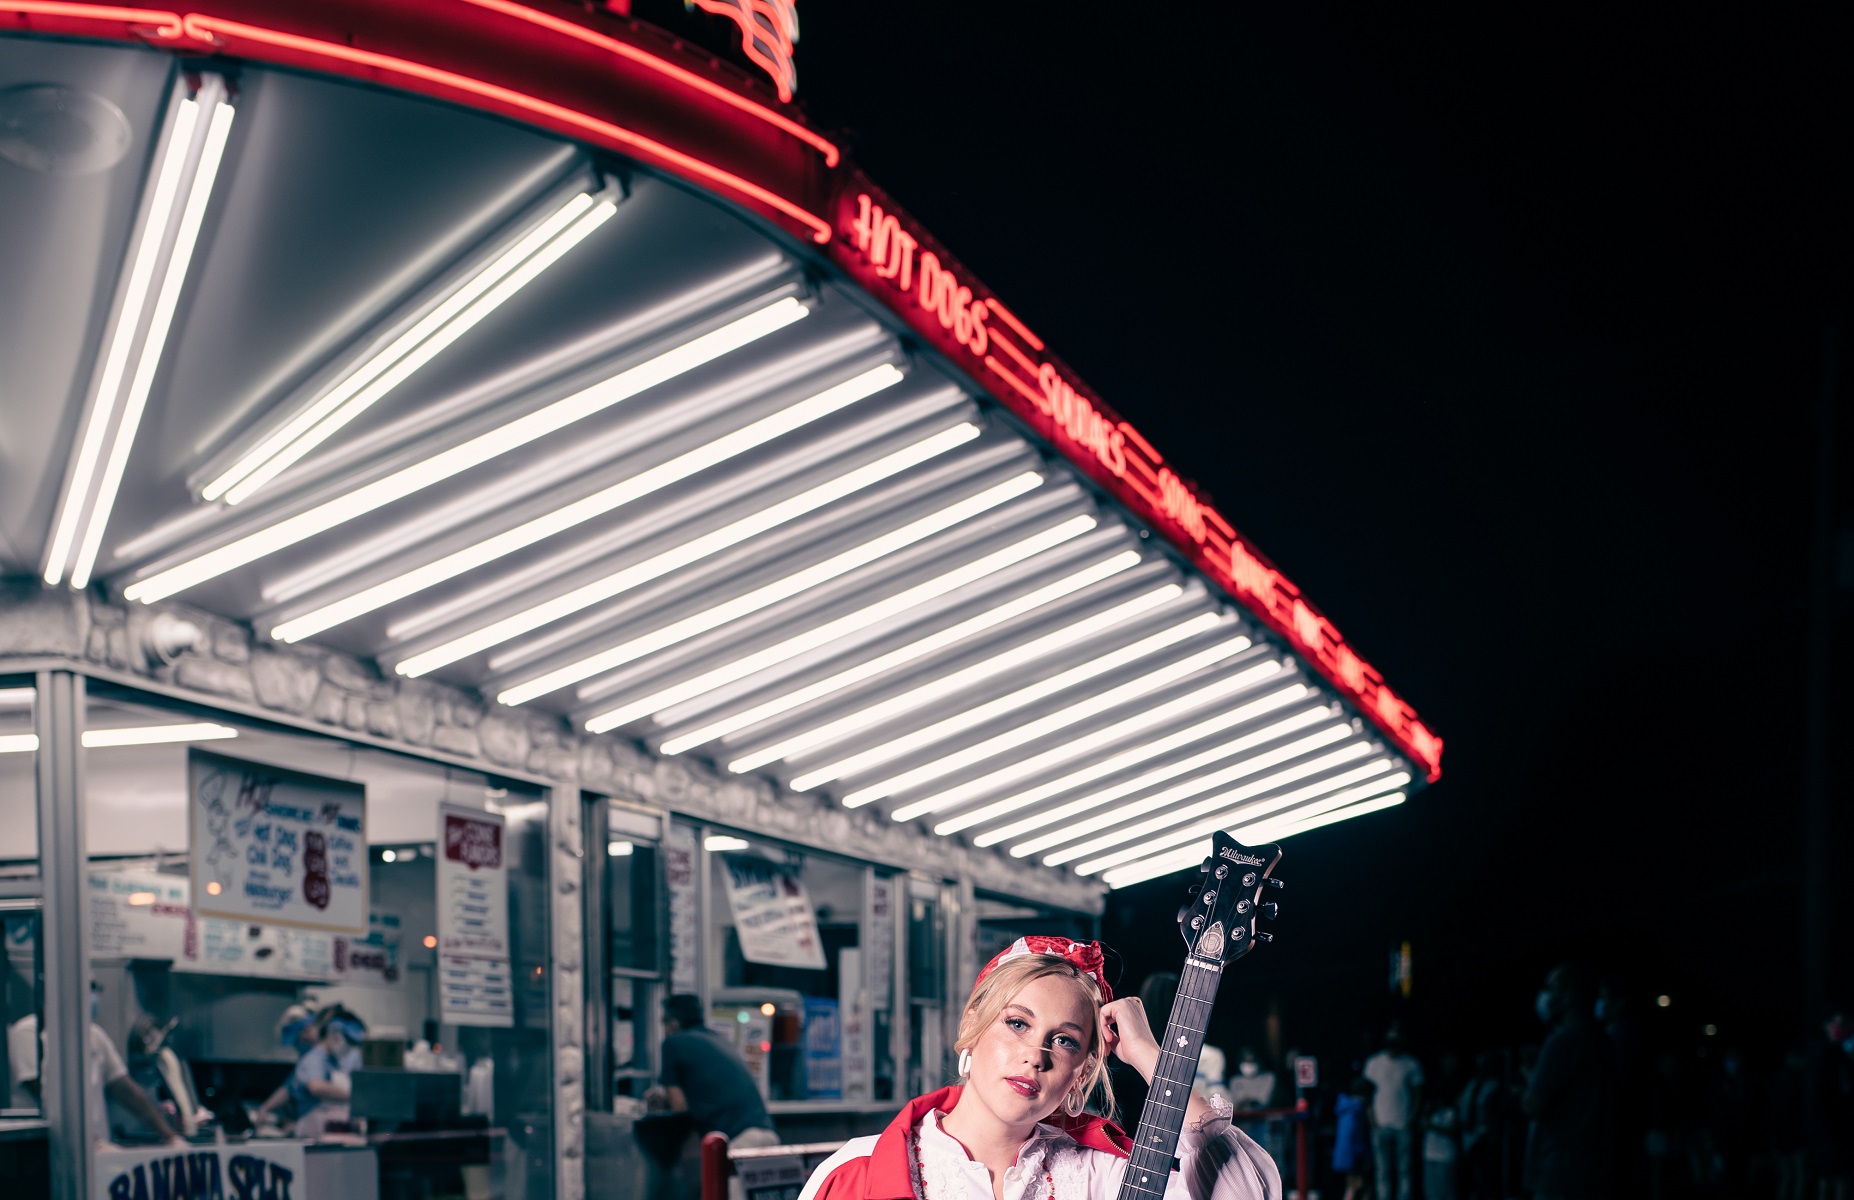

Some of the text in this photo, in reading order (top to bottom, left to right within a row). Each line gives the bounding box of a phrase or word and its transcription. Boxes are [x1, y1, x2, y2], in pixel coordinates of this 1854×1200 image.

[852, 193, 990, 356] HOT DOGS
[1038, 362, 1127, 478] SUNDAES
